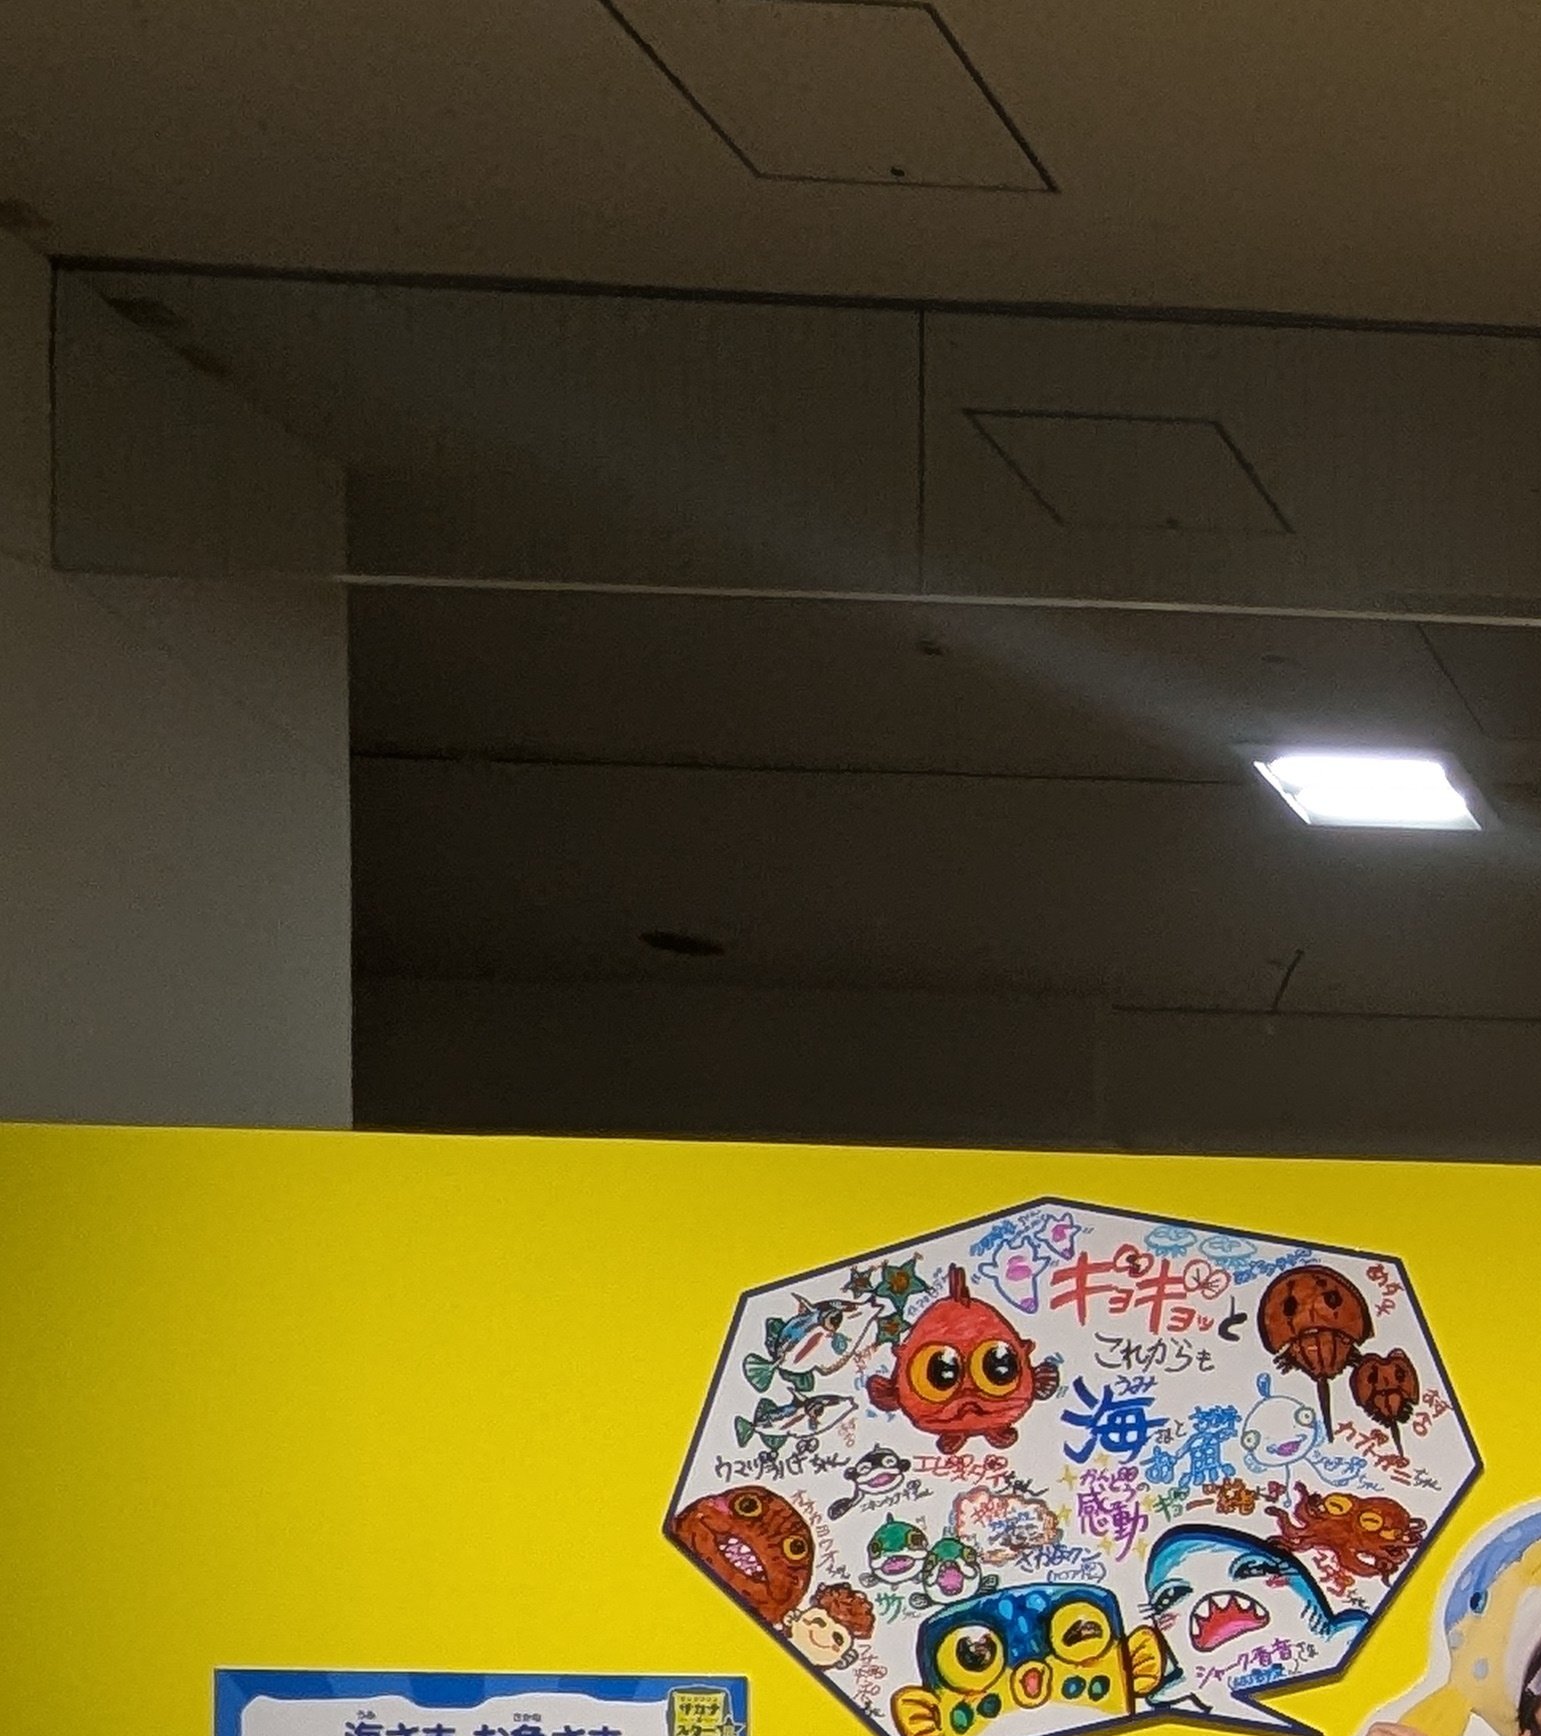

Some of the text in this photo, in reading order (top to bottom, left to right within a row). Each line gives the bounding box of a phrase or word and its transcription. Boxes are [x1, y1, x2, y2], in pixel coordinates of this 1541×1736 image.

[1094, 1332, 1215, 1373] これからも
